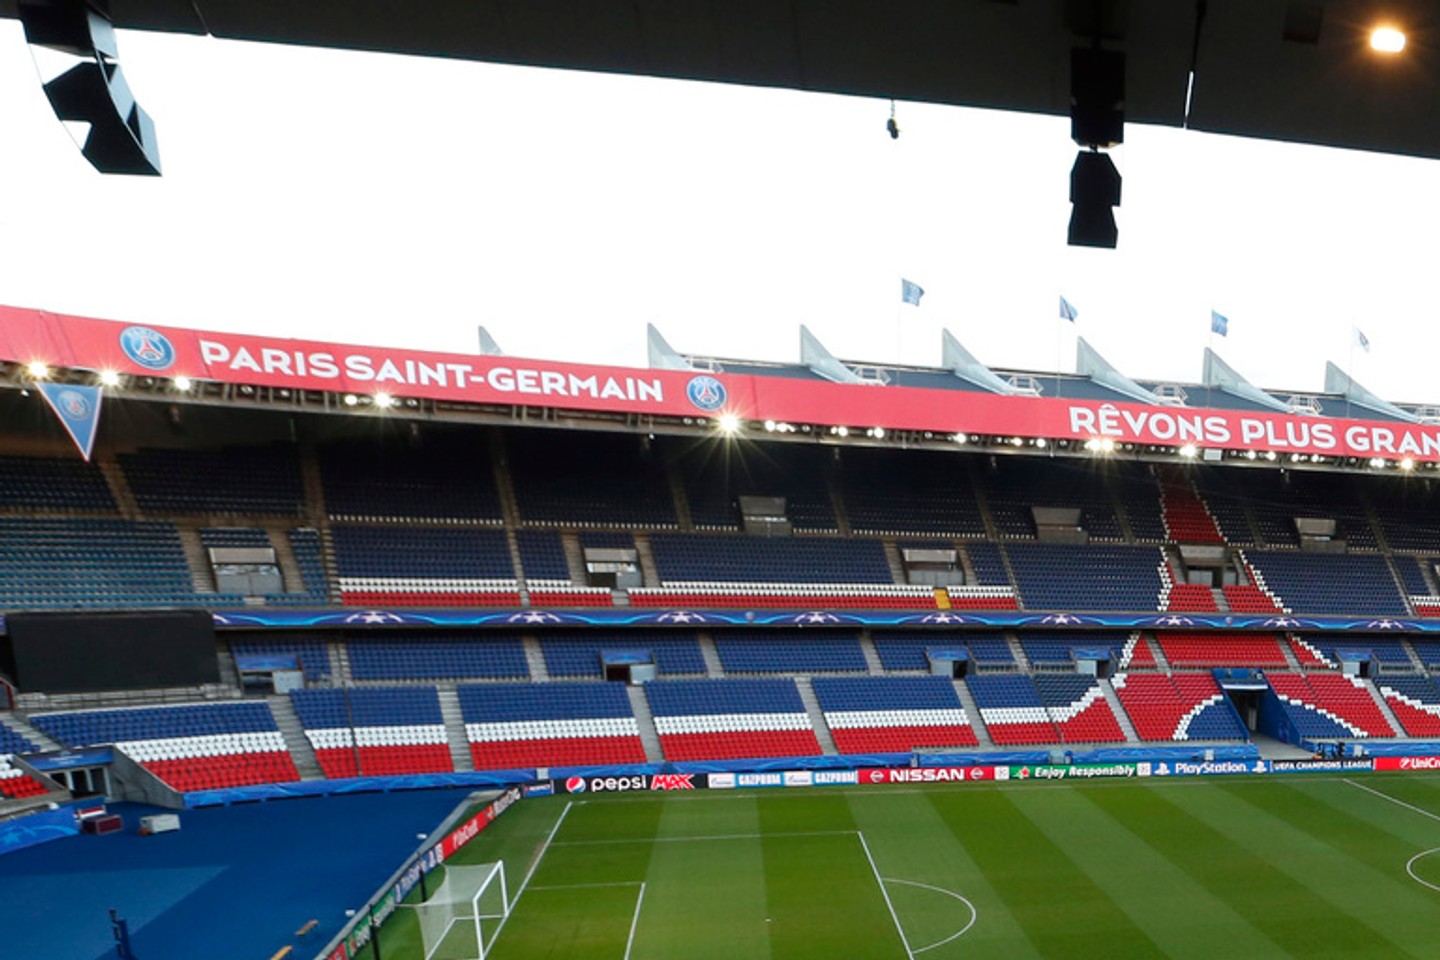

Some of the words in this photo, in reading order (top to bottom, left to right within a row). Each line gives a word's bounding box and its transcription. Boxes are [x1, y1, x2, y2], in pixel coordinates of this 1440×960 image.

[202, 340, 340, 378] PARIS
[344, 353, 663, 402] SAINT-GERMAIN
[1069, 404, 1231, 443] RÊVONS
[1241, 418, 1336, 448] PLUS
[1174, 762, 1248, 776] PlayStation
[1296, 760, 1341, 770] CHAMPIONS
[1343, 759, 1372, 769] LEAGUE
[890, 768, 965, 782] NISSAN
[1034, 766, 1066, 779] Enjoy
[1068, 765, 1135, 779] Responsibly
[591, 775, 648, 793] pepsi
[650, 773, 696, 791] MAX
